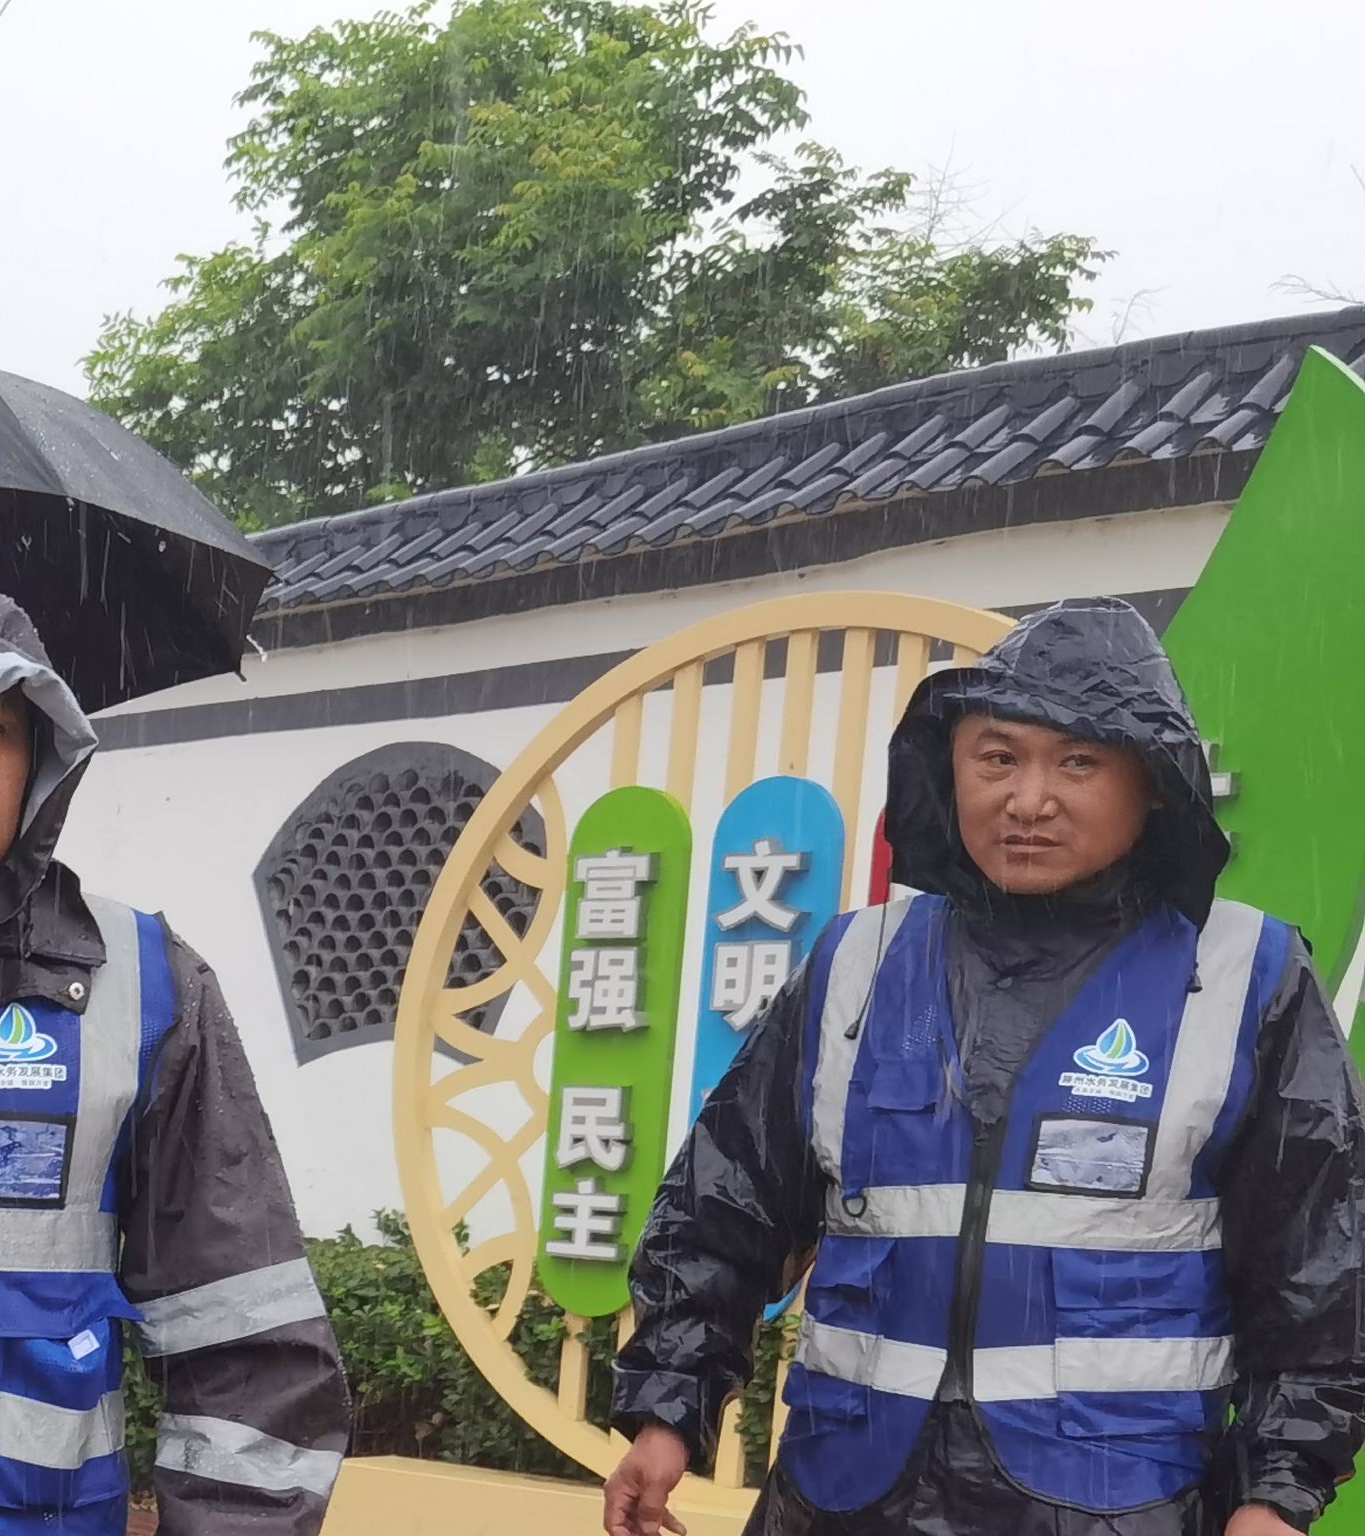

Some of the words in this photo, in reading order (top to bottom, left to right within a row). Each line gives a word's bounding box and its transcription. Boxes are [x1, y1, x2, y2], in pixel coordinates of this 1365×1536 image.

[568, 848, 656, 1034] 富强
[709, 839, 804, 1032] 文明
[545, 1086, 630, 1262] 民主
